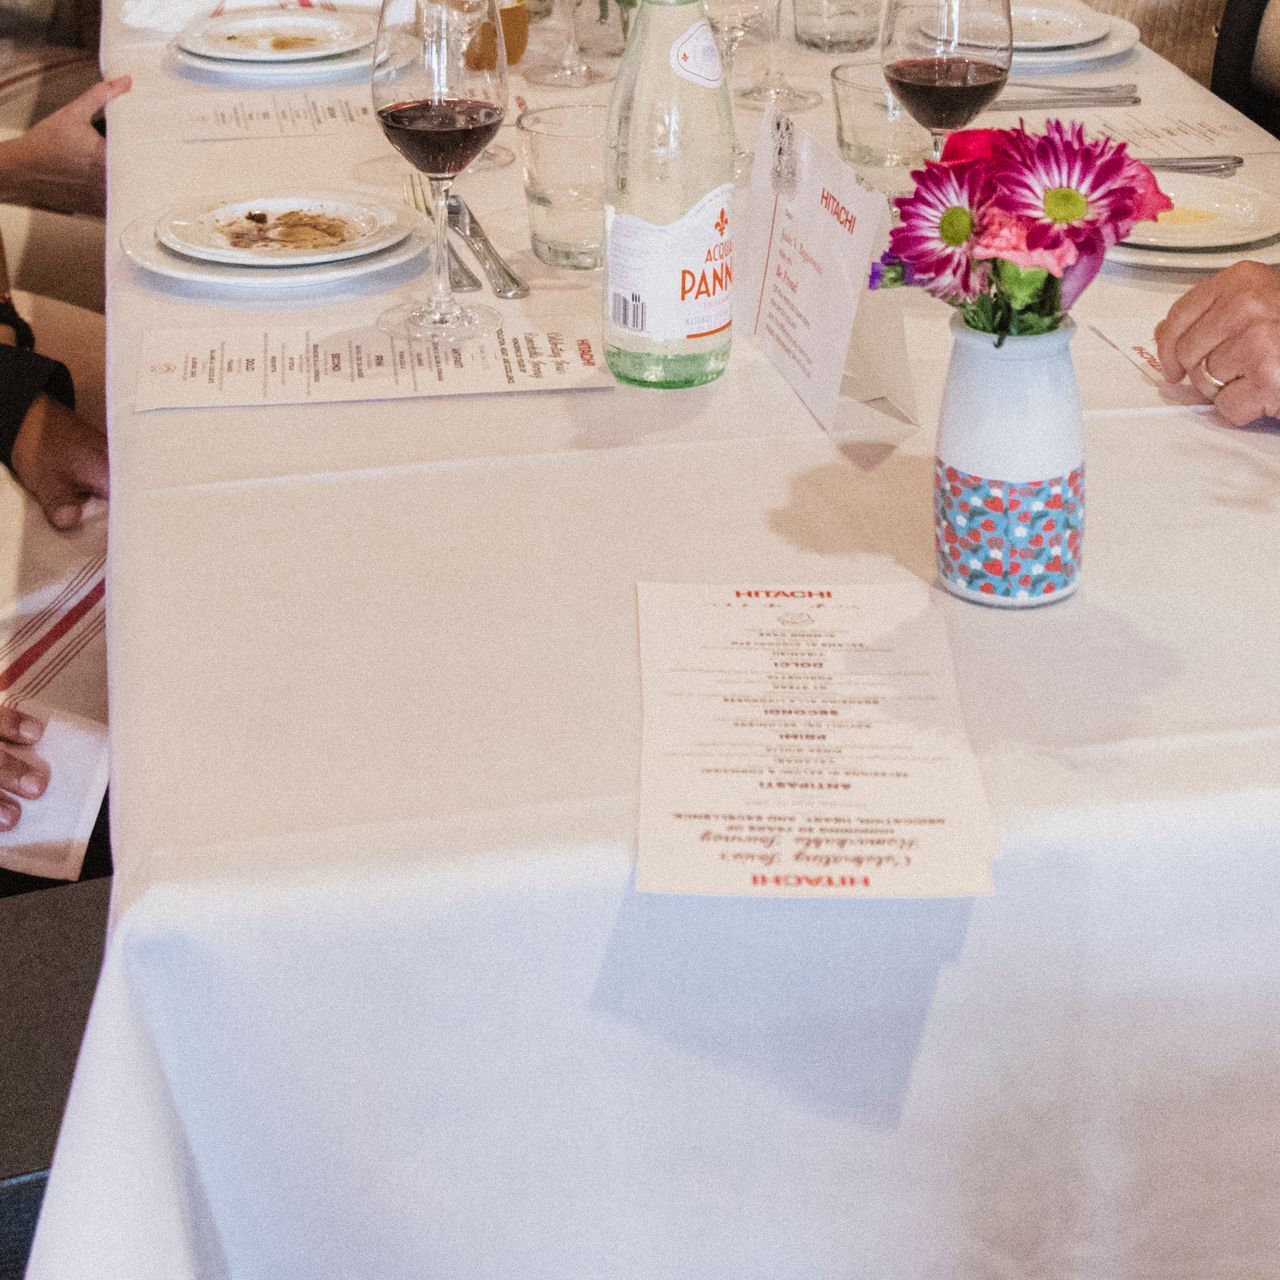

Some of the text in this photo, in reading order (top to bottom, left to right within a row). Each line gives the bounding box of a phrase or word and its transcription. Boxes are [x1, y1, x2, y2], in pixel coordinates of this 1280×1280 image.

[820, 186, 857, 236] HITACHI
[734, 589, 833, 599] HITACHI
[773, 661, 824, 669] DOLCI
[758, 781, 852, 791] ANTIPASTI
[751, 874, 871, 887] HITACHI
